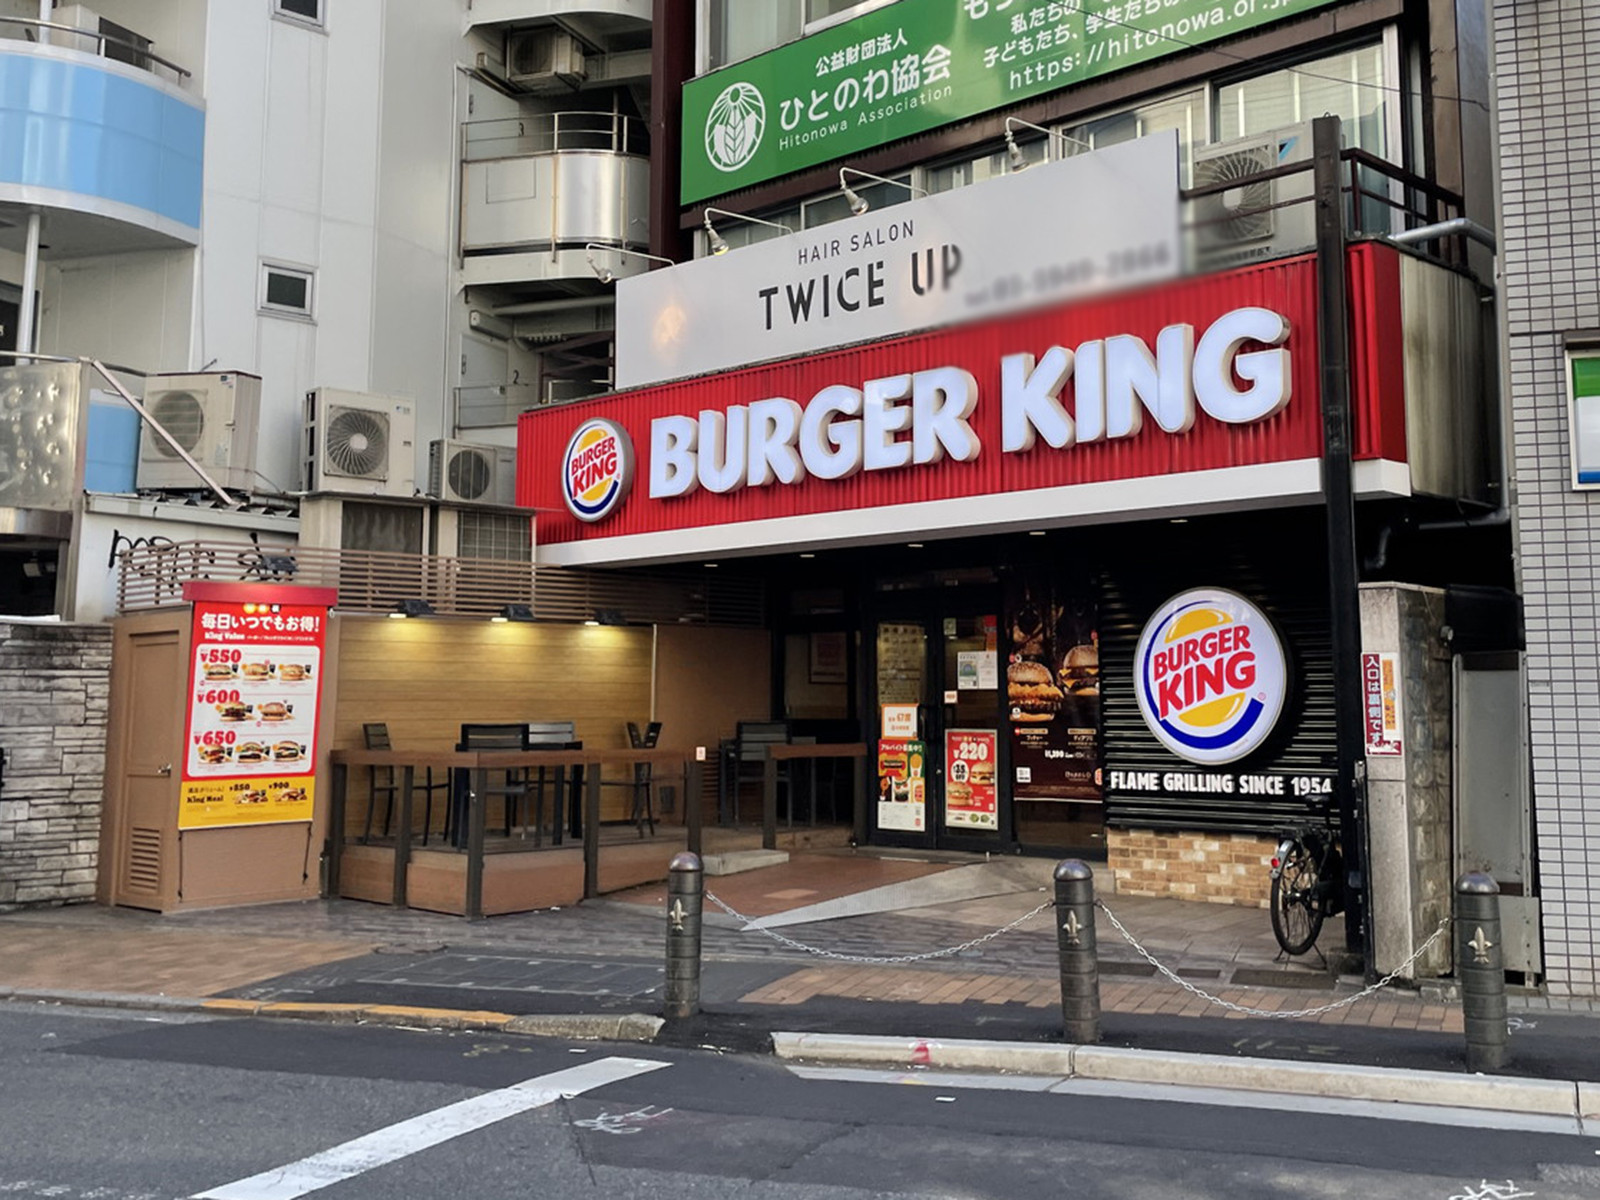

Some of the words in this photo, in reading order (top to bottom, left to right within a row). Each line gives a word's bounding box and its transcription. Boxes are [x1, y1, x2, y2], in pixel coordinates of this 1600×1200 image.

[964, 0, 1013, 19] も
[1010, 0, 1080, 35] 私たちの
[815, 28, 908, 77] 公益財団法人
[780, 44, 952, 131] ひとのわ協会
[779, 119, 848, 151] Hitonowa
[857, 85, 952, 126] Association
[798, 239, 840, 265] HAIR
[850, 220, 914, 252] SALON
[758, 260, 884, 330] TWICE
[911, 243, 962, 296] UP
[649, 365, 981, 500] BURGER
[1001, 306, 1293, 454] KING
[571, 436, 616, 477] BURGER
[573, 452, 618, 499] KING
[200, 649, 242, 664] ¥550
[1153, 625, 1251, 682] BURGER
[197, 689, 240, 704] ¥600
[1158, 651, 1256, 718] KING
[193, 730, 237, 745] ¥650
[1109, 771, 1160, 791] FLAME
[1162, 773, 1235, 793] GRILLING
[1239, 775, 1284, 795] SINCE
[1290, 777, 1333, 796] 1954
